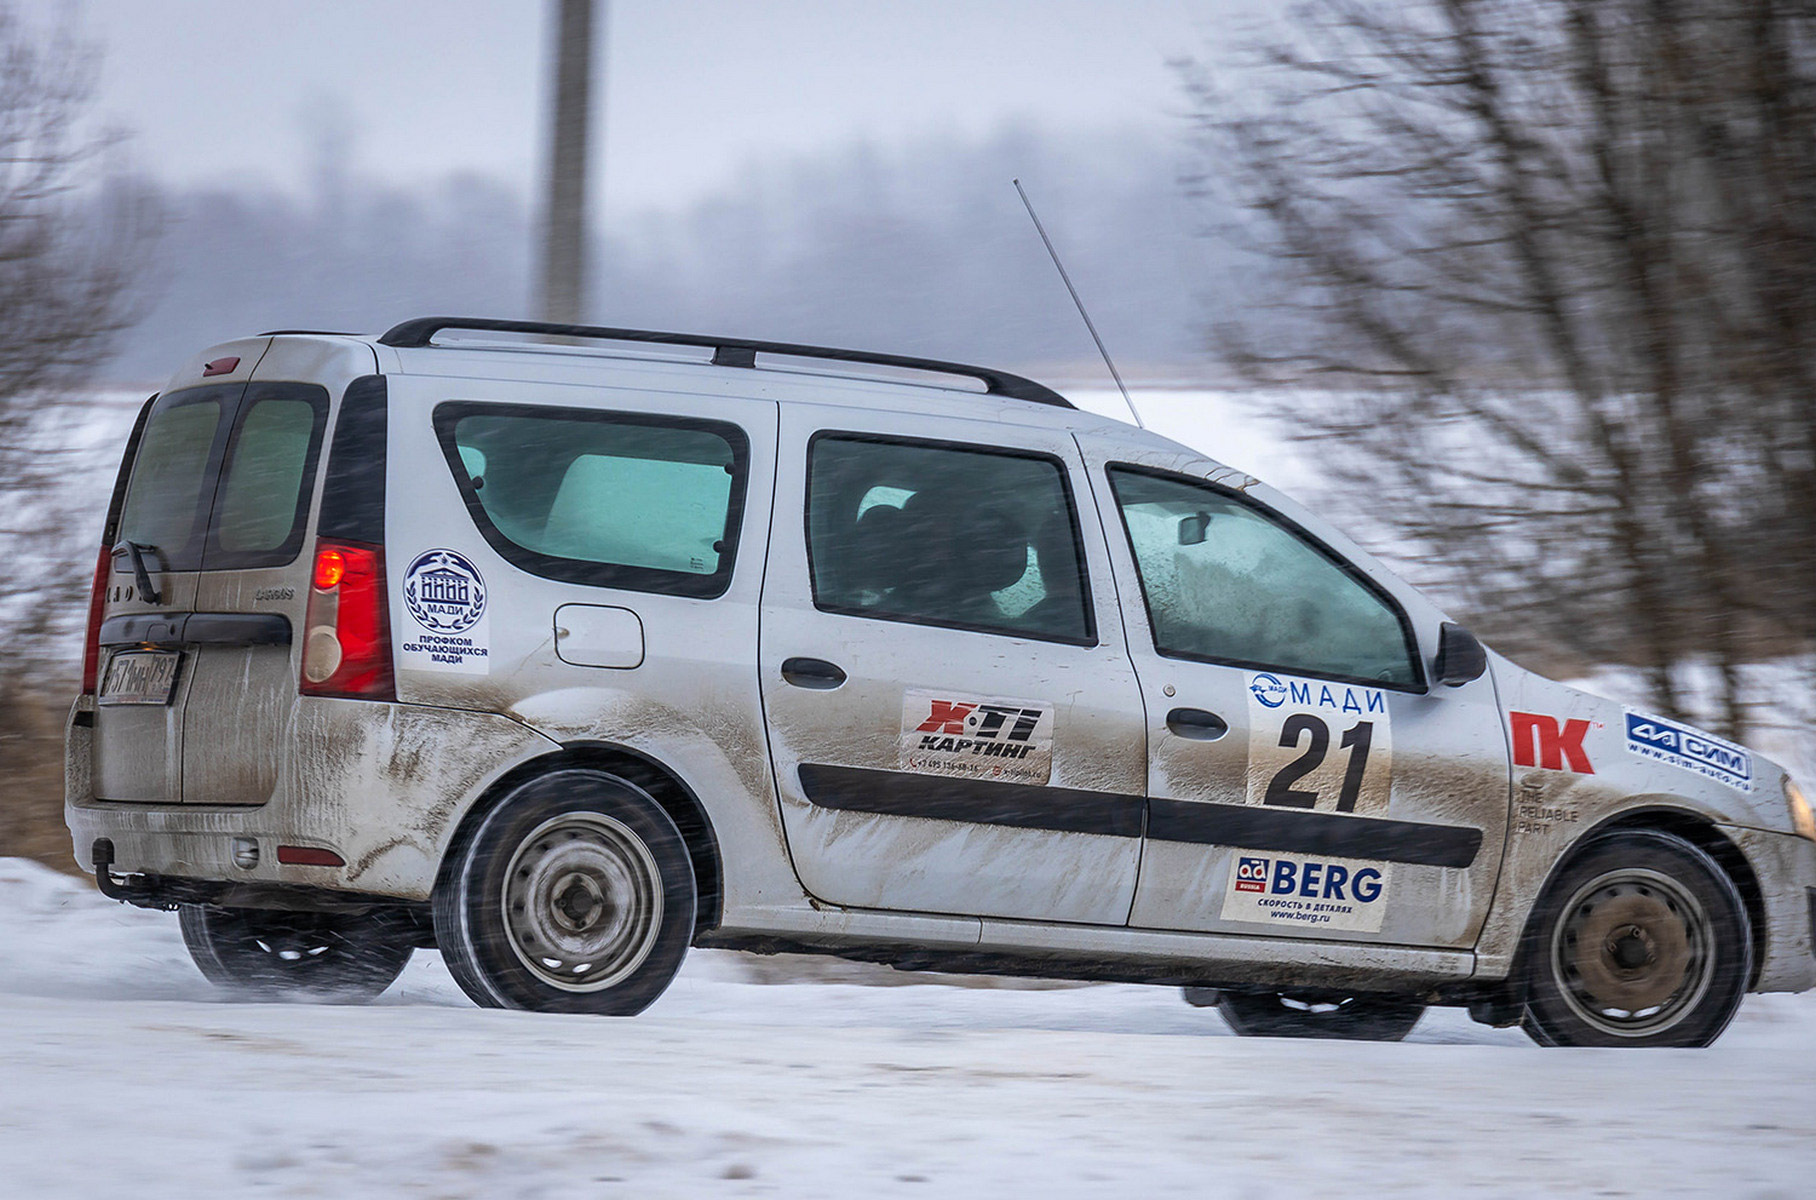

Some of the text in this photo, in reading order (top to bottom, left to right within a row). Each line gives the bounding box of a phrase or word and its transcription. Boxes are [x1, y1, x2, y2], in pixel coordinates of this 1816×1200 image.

[427, 603, 463, 615] МАДИ
[419, 635, 472, 646] ПРОФКОМ
[403, 643, 488, 656] ОБУЧАЮЩИХСЯ
[431, 654, 463, 664] МАДИ
[1290, 681, 1384, 715] МАДИ
[918, 736, 1036, 759] КАРТИНГ
[1685, 738, 1743, 771] СИМ
[1264, 713, 1374, 813] 21
[1628, 743, 1750, 791] www.sim-auto.ru
[1519, 789, 1544, 804] THE
[1518, 805, 1578, 823] RELIABLE
[1516, 821, 1550, 835] PART
[1271, 860, 1383, 903] BERG
[1258, 899, 1353, 914] СКОРОСТЬ В ДЕТАЛЯХ
[1271, 910, 1330, 923] www.berg.ru
